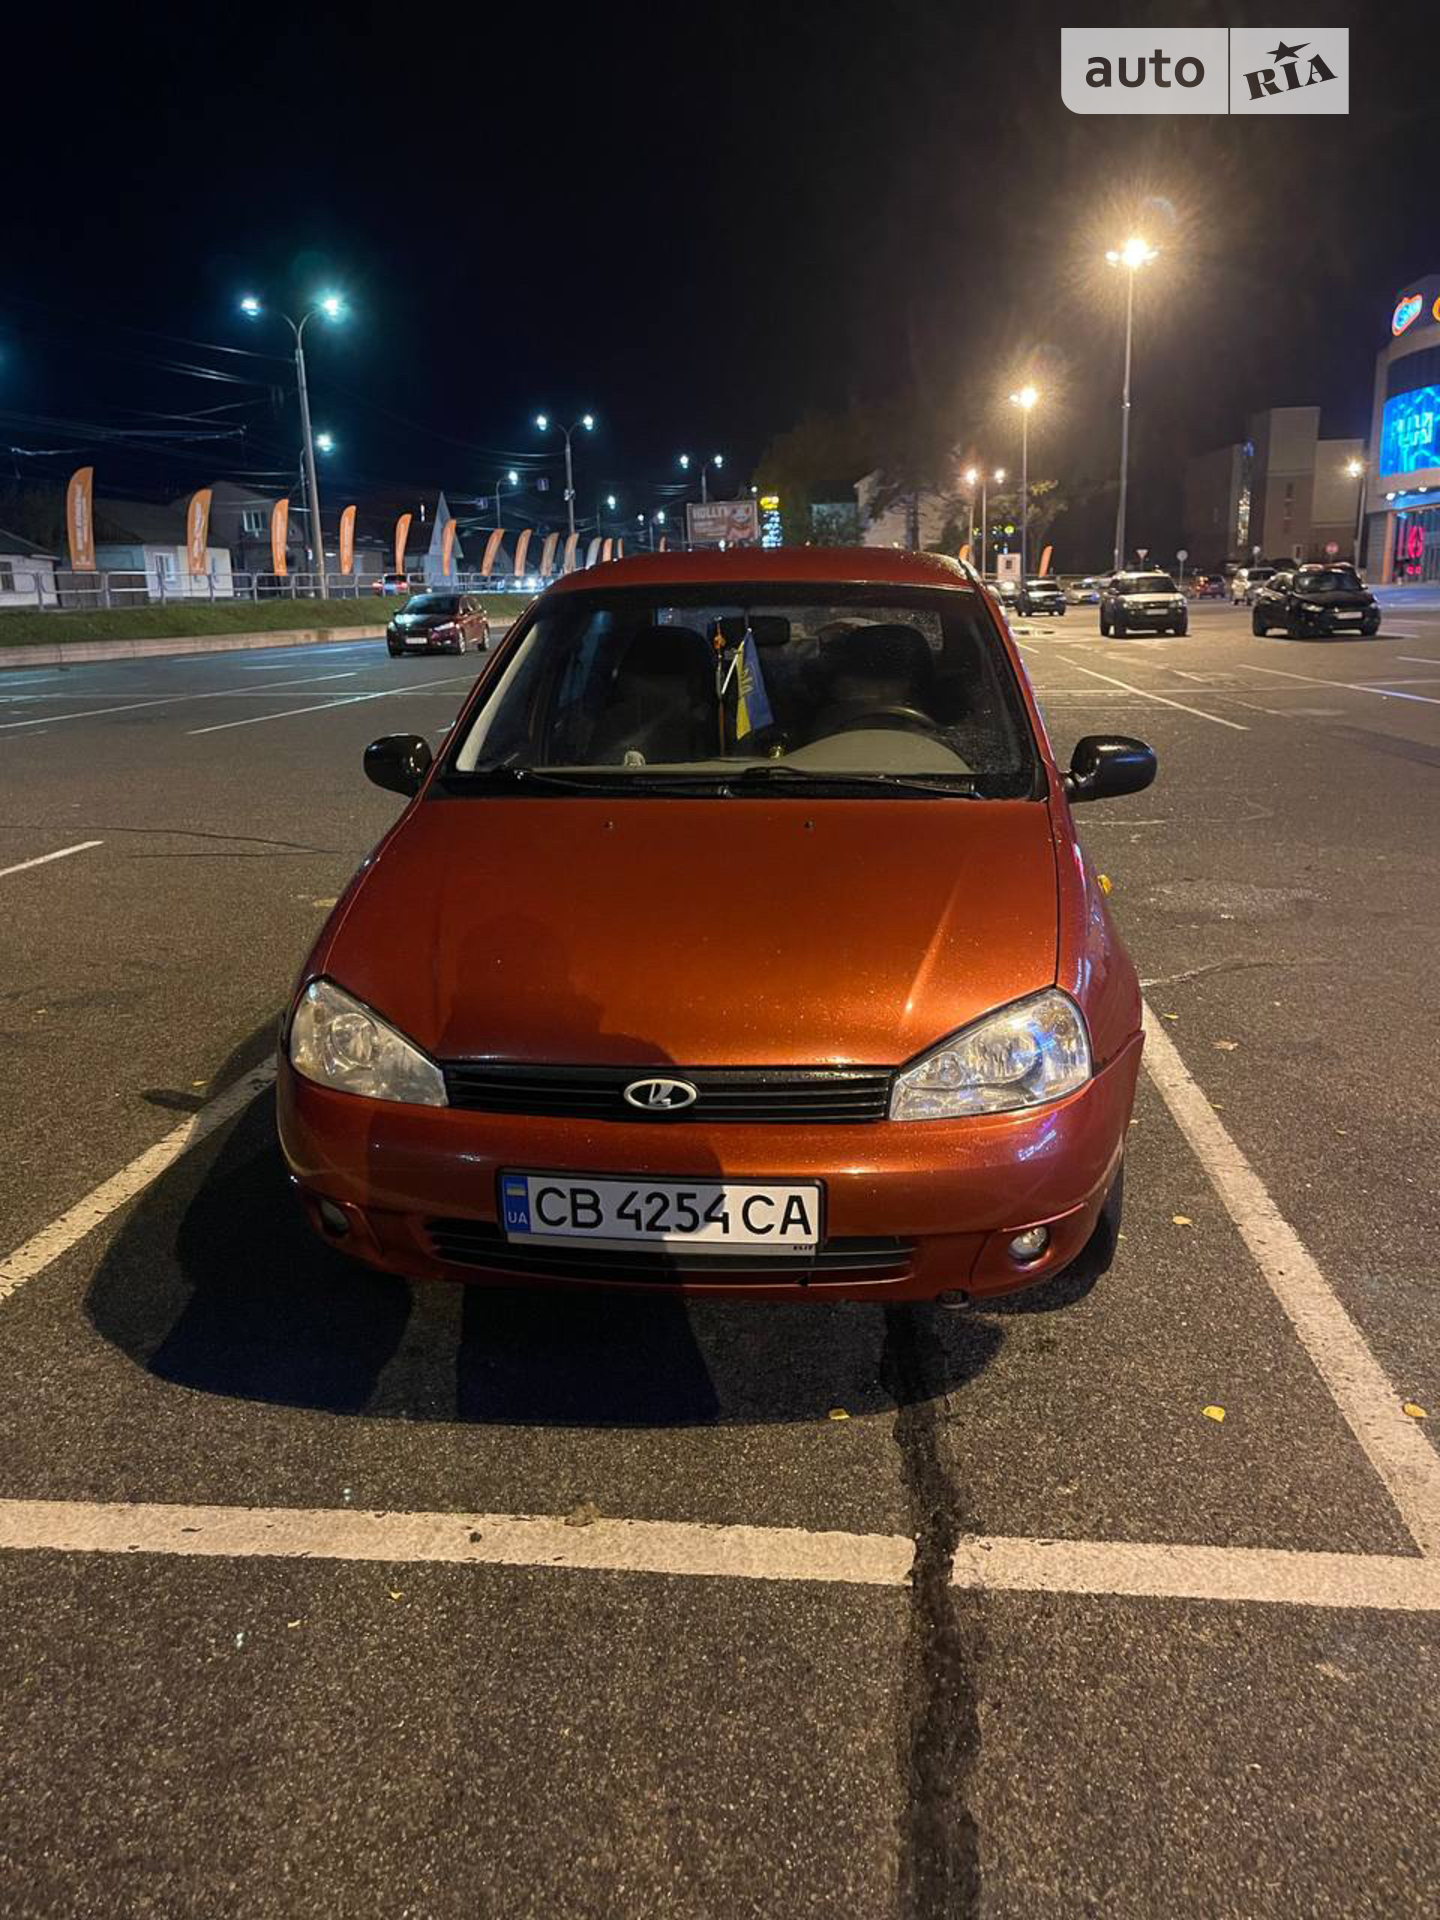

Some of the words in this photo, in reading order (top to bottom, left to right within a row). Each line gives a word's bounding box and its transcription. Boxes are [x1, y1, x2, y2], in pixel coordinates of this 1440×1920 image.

[507, 1211, 529, 1225] UA
[535, 1186, 604, 1229] CB
[616, 1190, 730, 1235] 4254
[741, 1194, 812, 1236] CA
